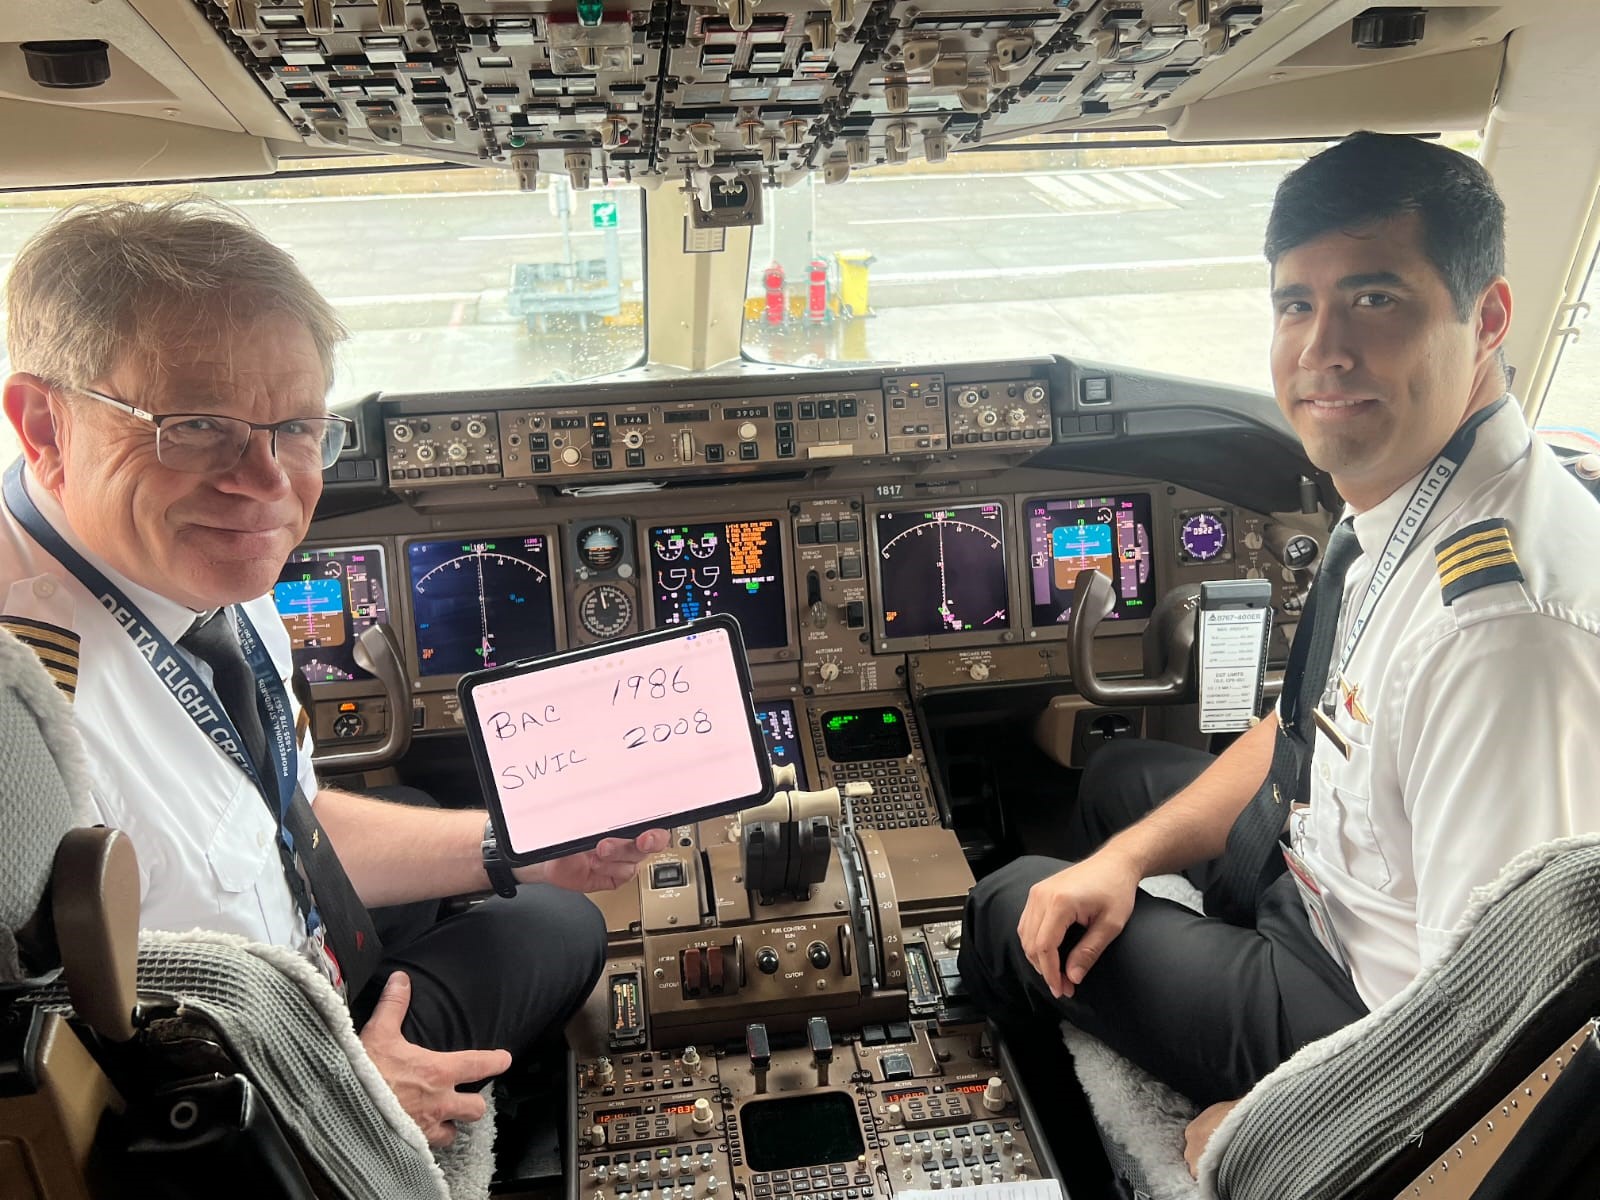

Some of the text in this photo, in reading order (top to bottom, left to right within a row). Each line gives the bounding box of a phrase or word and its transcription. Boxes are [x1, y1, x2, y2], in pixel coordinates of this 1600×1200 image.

[876, 485, 902, 496] 1817
[1369, 550, 1398, 596] Pilot
[1393, 462, 1452, 546] Training
[99, 593, 159, 663] DELTA
[157, 655, 219, 727] FLIGHT
[257, 678, 278, 720] STANDARDS
[486, 665, 691, 741] BAC 1986
[273, 720, 289, 778] PROFESSIONAL
[501, 708, 713, 790] SWIC 2008
[884, 901, 892, 909] 20
[783, 925, 807, 933] CONTROL
[888, 935, 897, 943] 25
[784, 971, 804, 979] CUTOFF
[891, 969, 901, 978] 30
